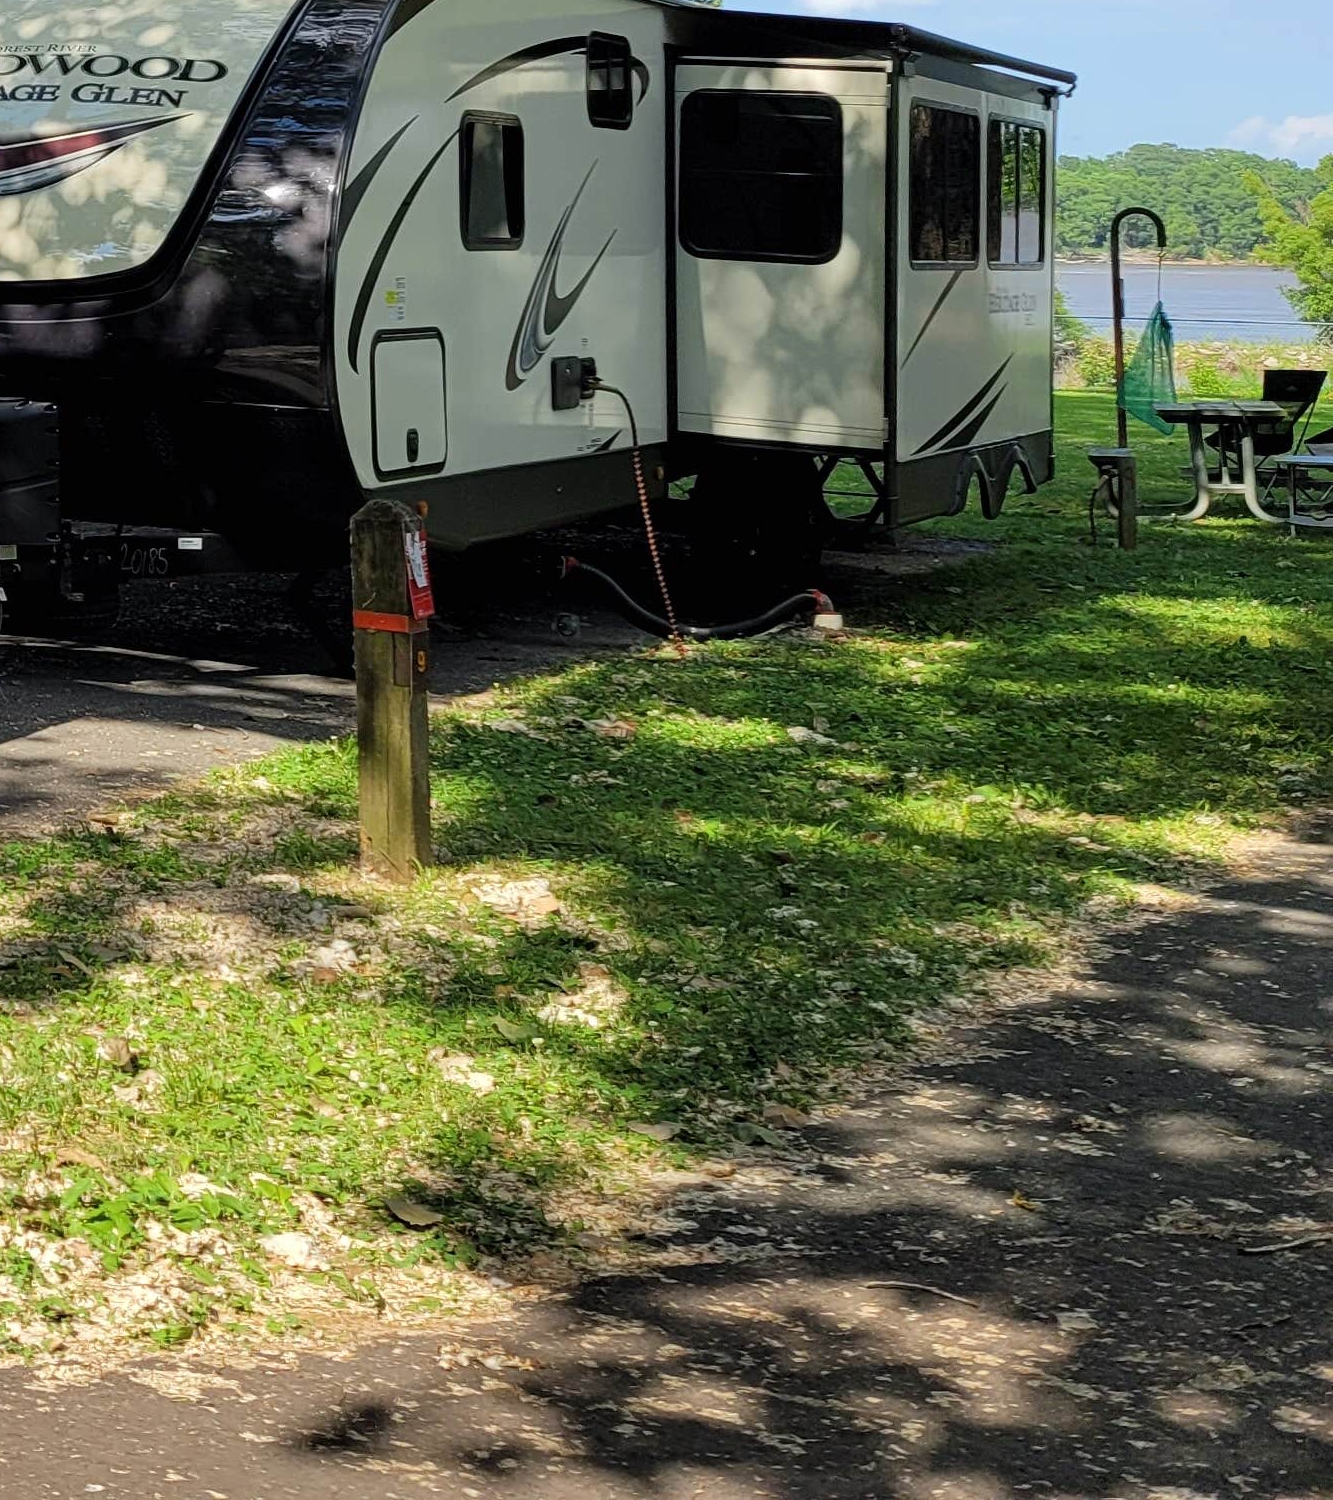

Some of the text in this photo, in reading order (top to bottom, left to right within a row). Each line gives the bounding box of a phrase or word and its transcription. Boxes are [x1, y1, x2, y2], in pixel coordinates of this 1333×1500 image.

[46, 42, 98, 53] RIVER
[70, 82, 189, 108] GLEN
[120, 542, 169, 575] 20185
